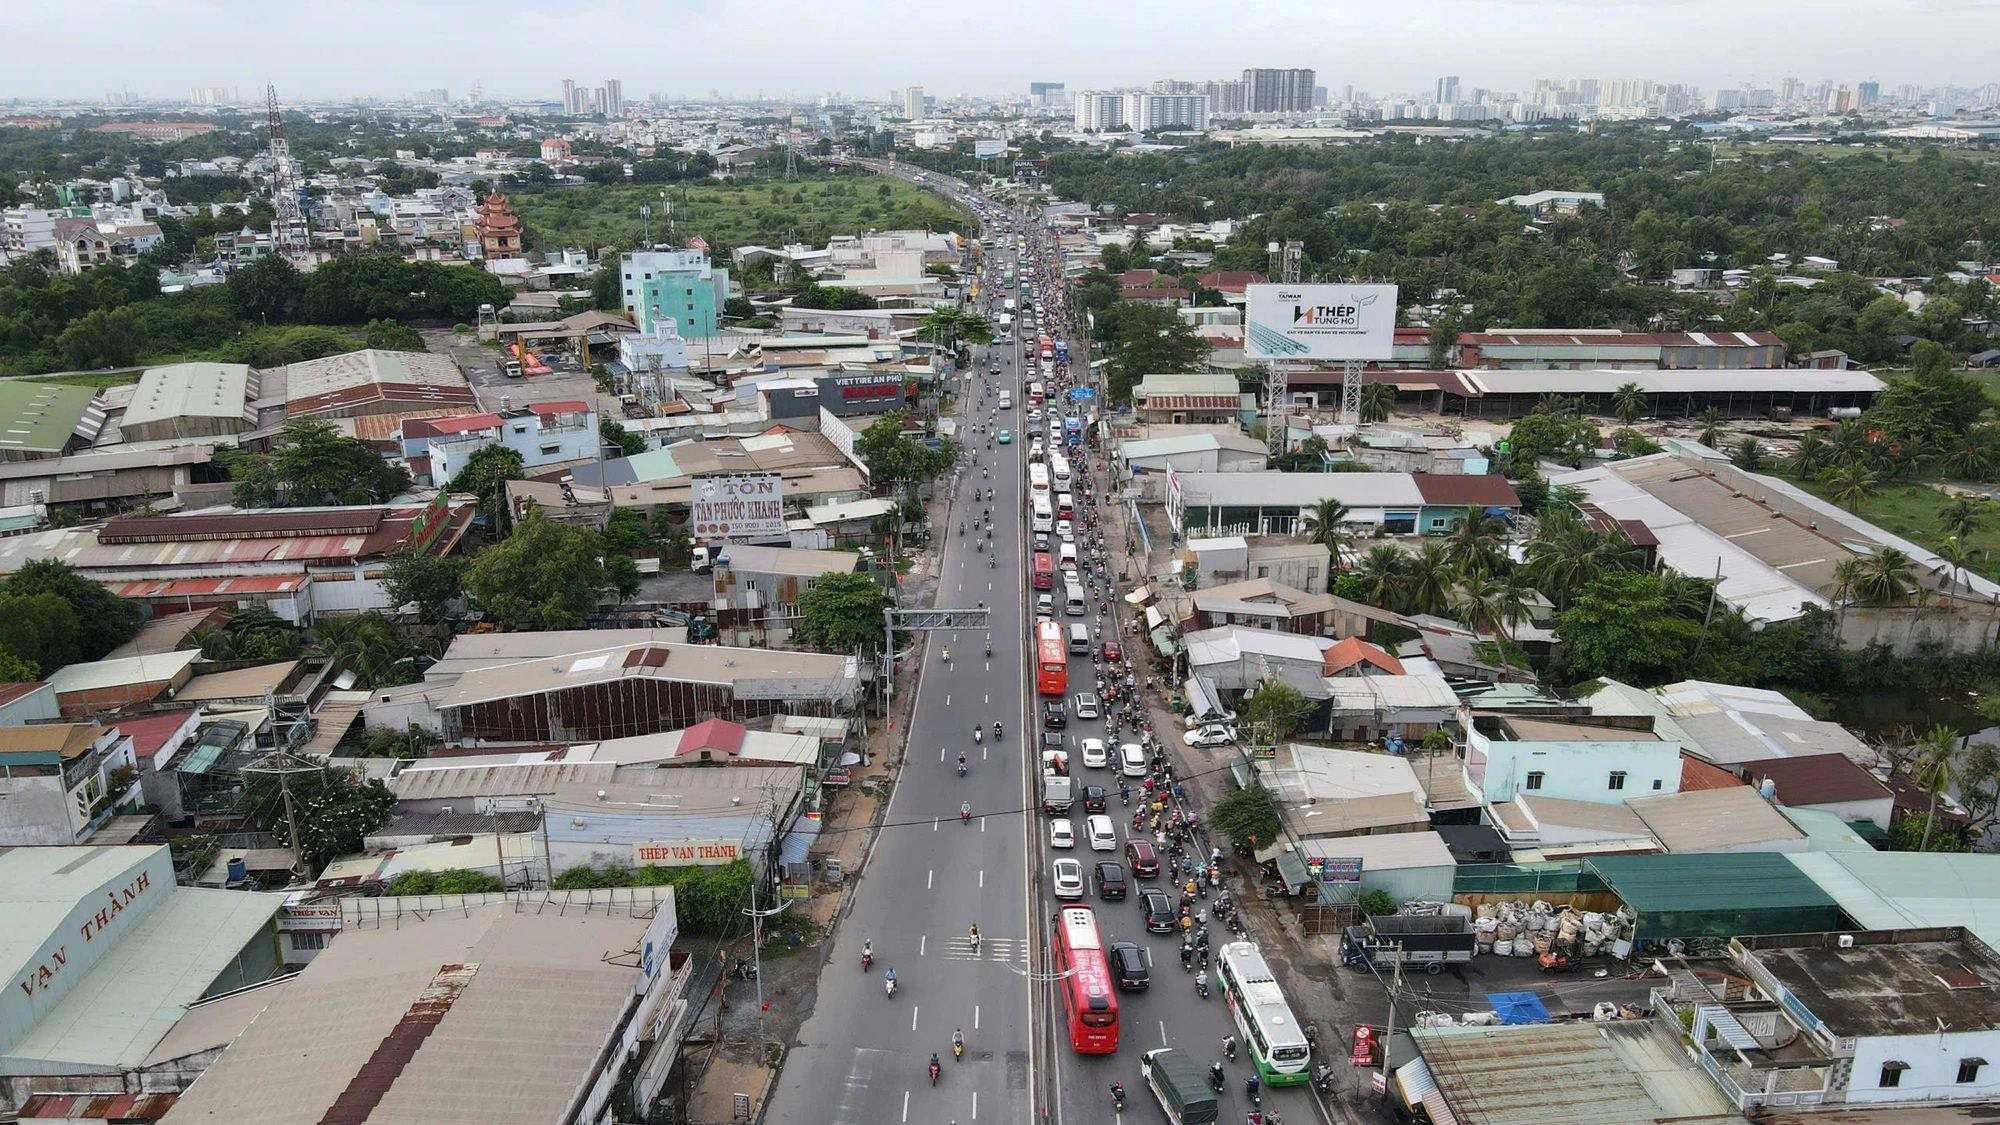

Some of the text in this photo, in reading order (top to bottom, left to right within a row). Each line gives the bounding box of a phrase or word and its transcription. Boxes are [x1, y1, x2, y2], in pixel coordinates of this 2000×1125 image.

[1316, 304, 1355, 317] THÉP
[1314, 317, 1355, 325] TUNG HO
[873, 375, 885, 383] AN
[694, 496, 780, 522] TÂN PHƯỚC KHANH
[744, 521, 760, 529] 9001
[639, 842, 737, 862] THÉP VẠN THÀNH
[20, 870, 151, 997] VẠN THÀNH
